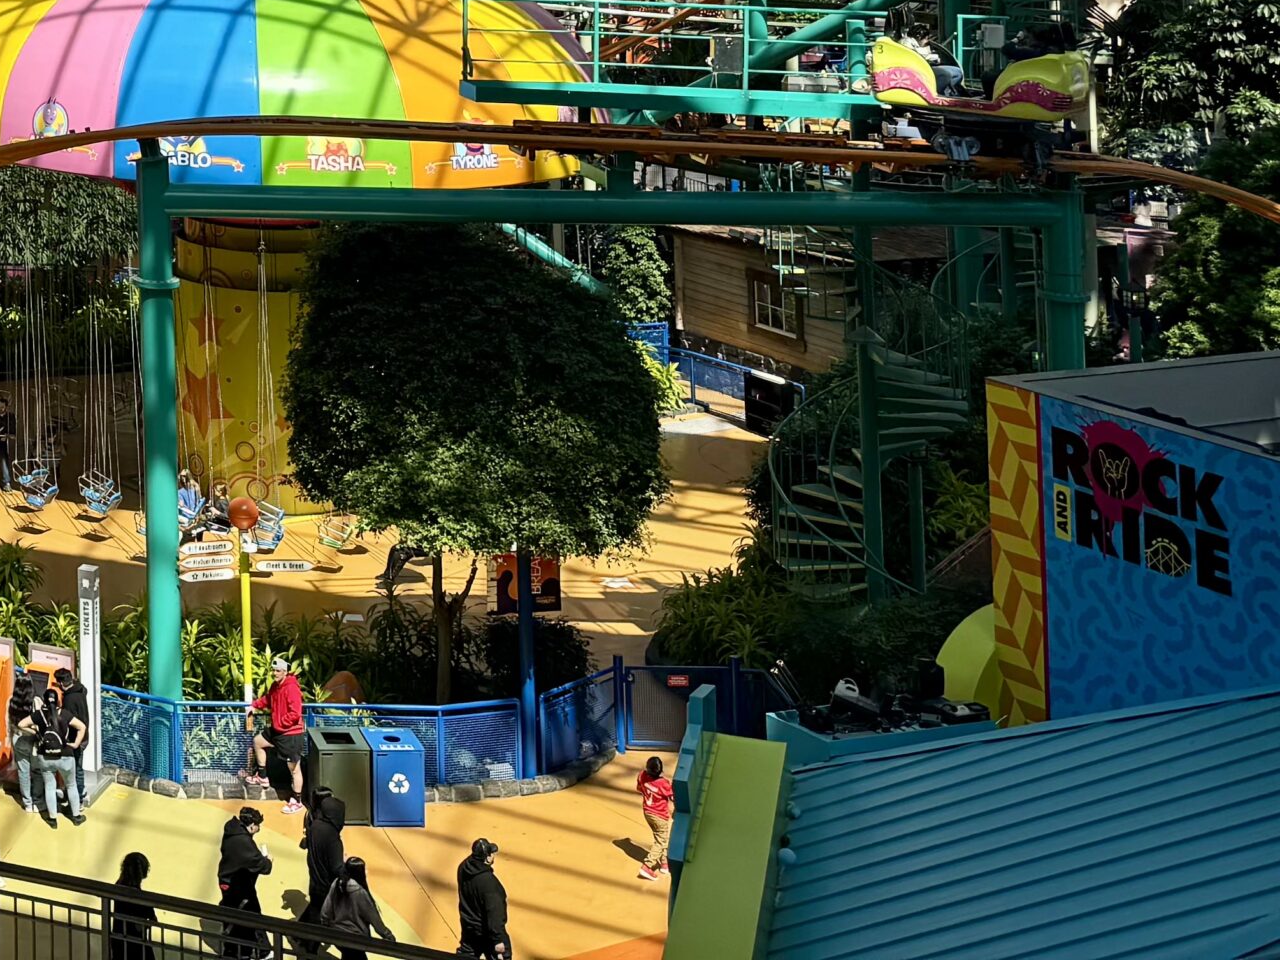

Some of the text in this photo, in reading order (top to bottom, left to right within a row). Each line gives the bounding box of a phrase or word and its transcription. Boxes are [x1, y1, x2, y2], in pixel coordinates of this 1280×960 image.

[877, 44, 884, 54] 3
[307, 154, 366, 172] TASHA
[450, 154, 499, 169] TYRONE
[1051, 426, 1228, 532] ROCK
[1056, 490, 1069, 535] AND
[1074, 488, 1233, 598] RIDE
